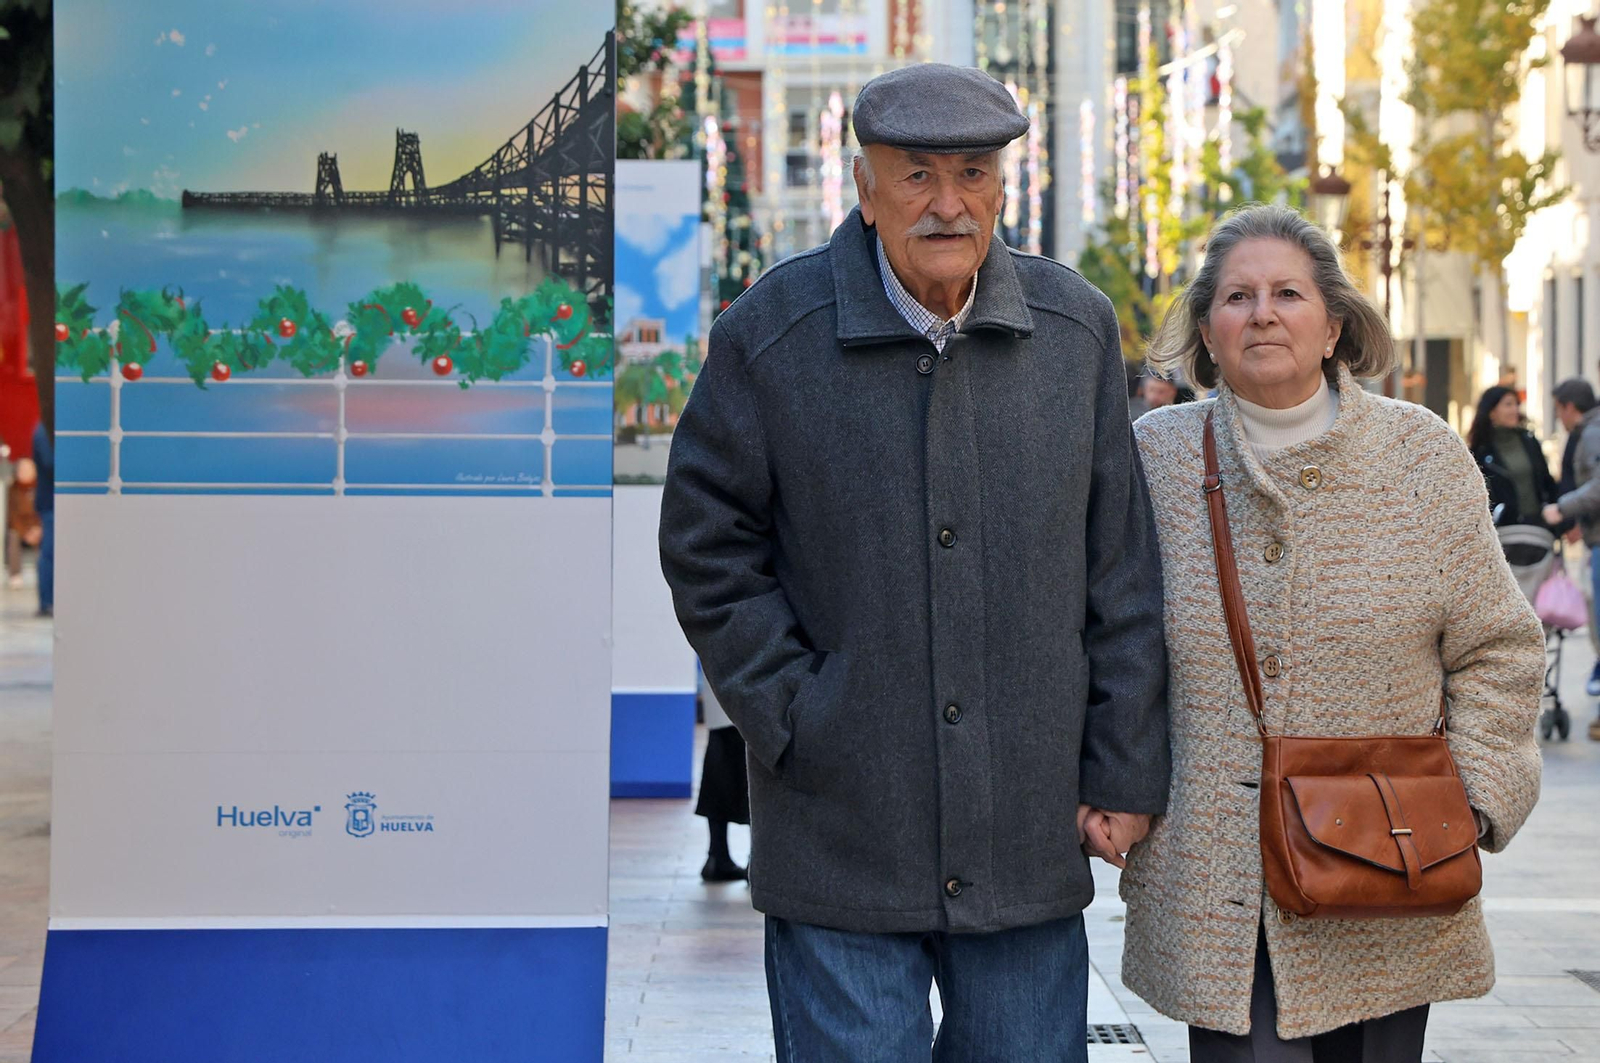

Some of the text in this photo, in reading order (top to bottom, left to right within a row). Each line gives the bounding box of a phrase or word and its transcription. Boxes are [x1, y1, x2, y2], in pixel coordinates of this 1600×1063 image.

[216, 805, 313, 827] Huelva
[380, 822, 434, 832] HUELVA
[279, 830, 312, 839] original
